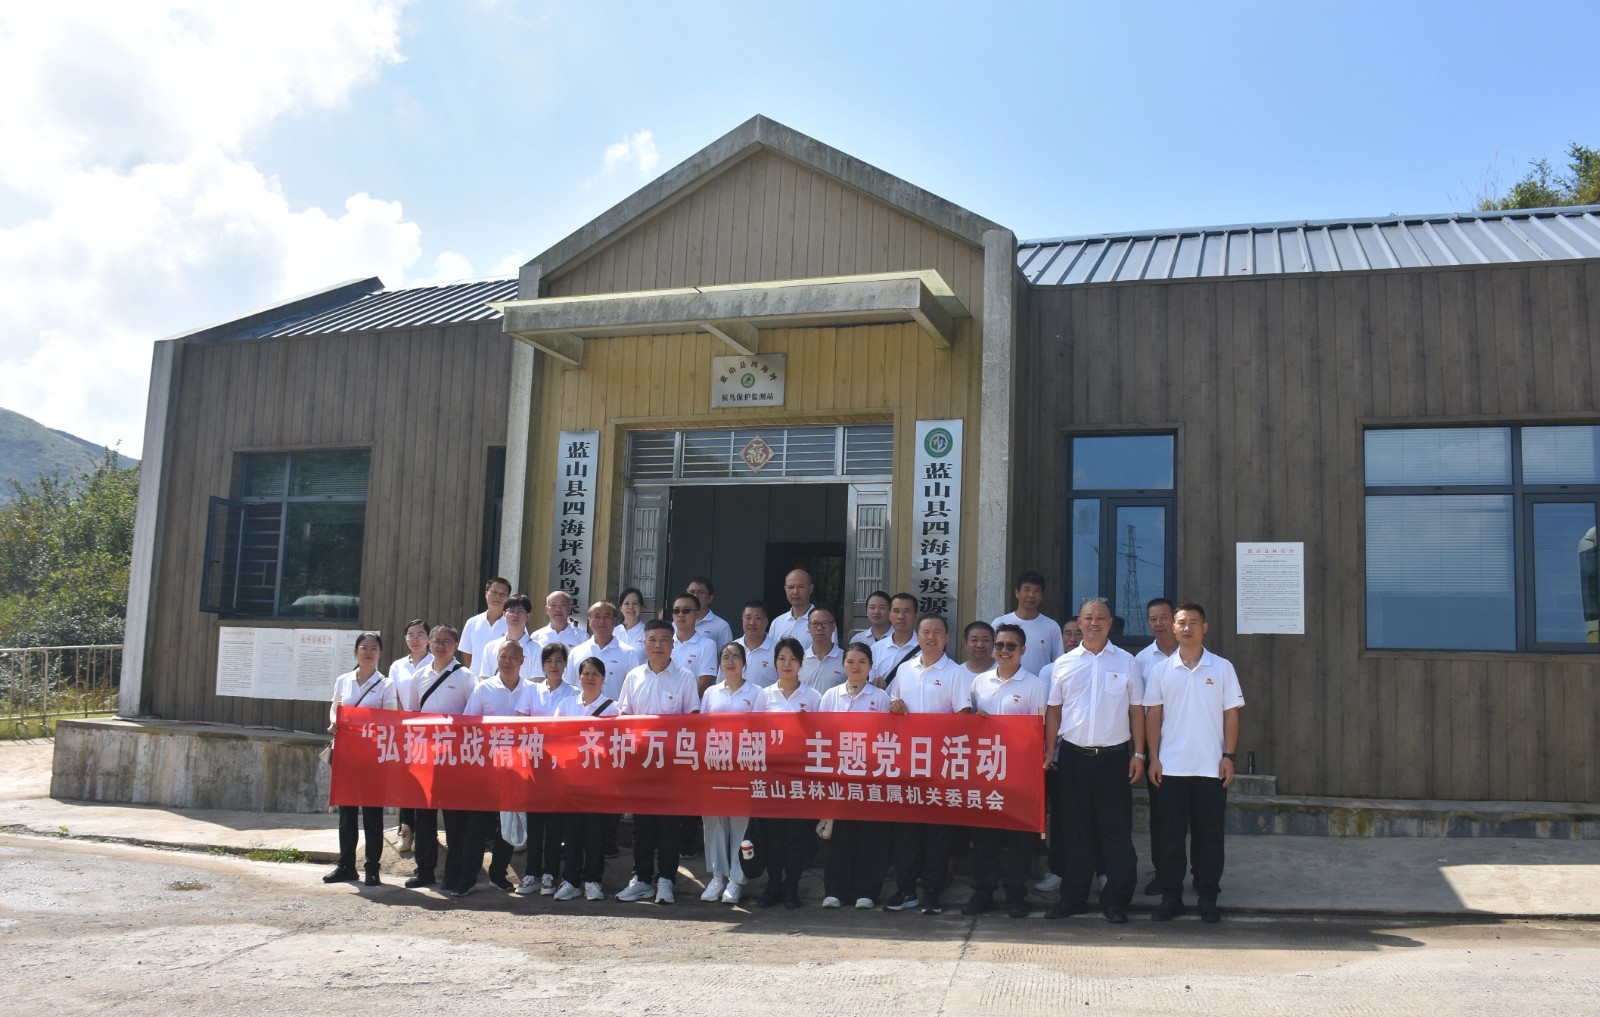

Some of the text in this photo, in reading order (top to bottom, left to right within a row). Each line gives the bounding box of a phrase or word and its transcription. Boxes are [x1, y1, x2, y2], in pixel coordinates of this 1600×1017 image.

[721, 392, 774, 402] 候鸟保护监测站
[918, 462, 953, 620] 蓝山县四海坪疫源
